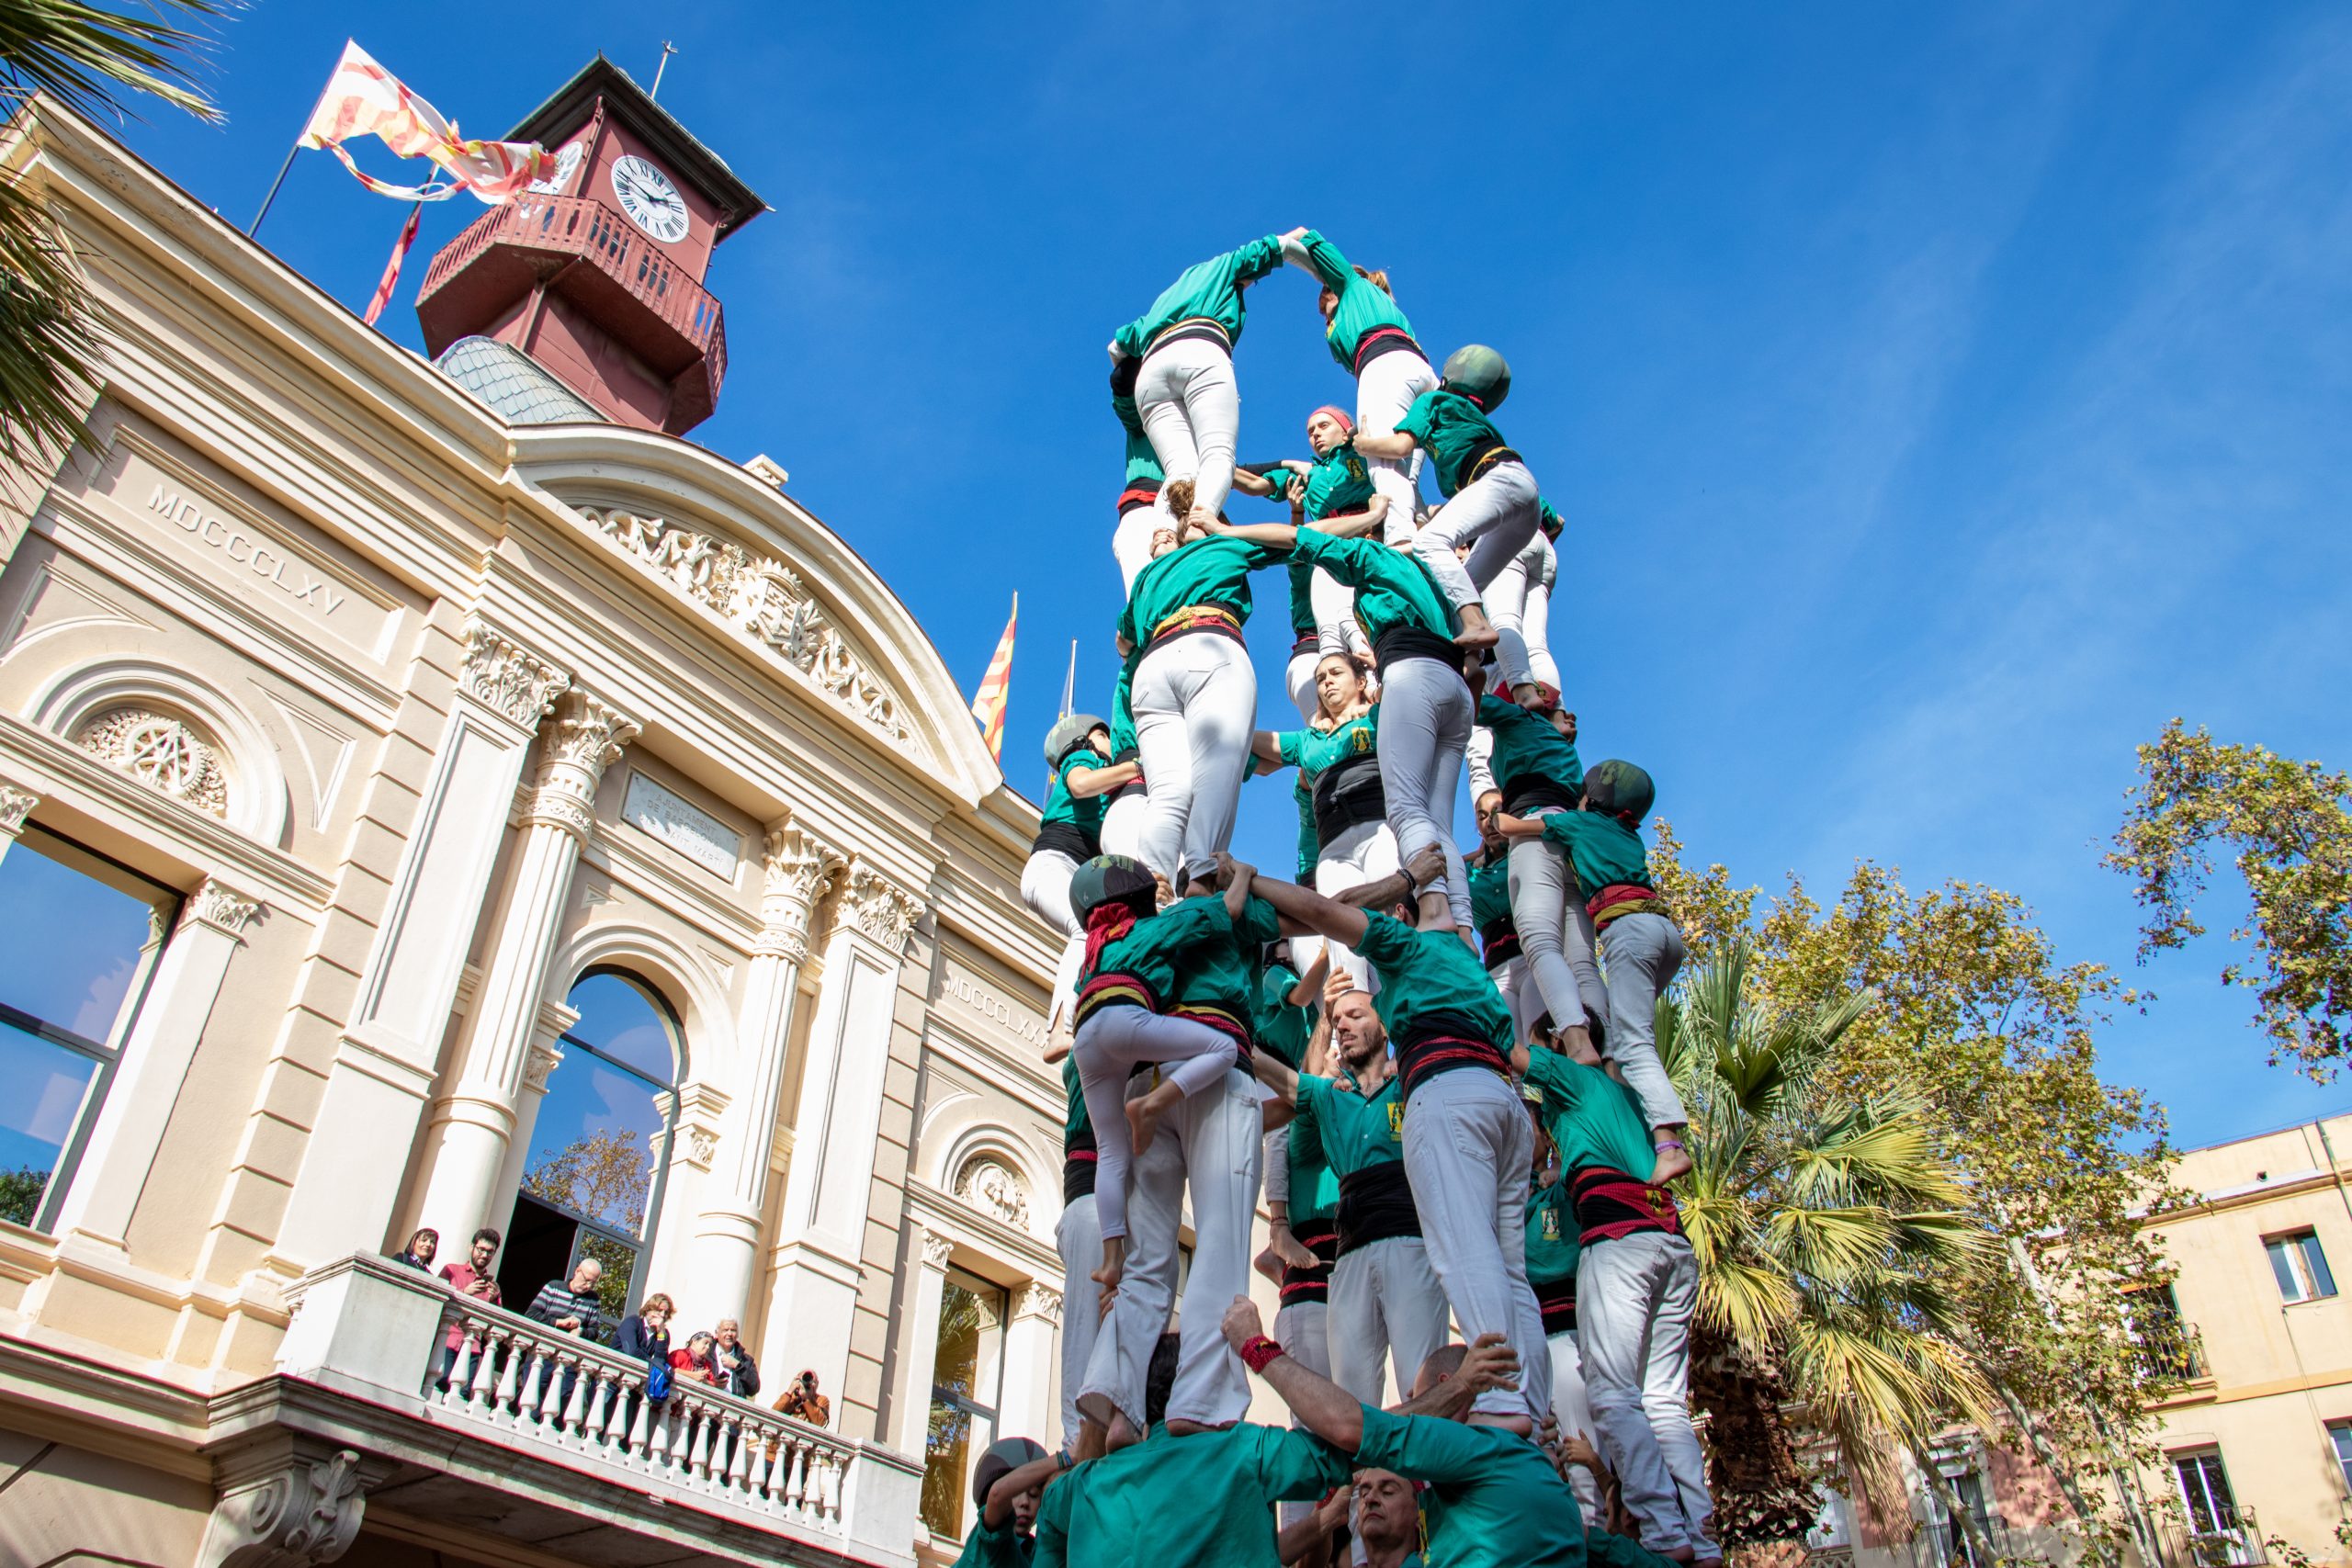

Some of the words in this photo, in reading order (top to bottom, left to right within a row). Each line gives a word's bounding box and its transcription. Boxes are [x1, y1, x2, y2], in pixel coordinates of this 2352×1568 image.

[147, 483, 345, 615] MDCCCLXV
[647, 799, 660, 813] DE
[664, 812, 721, 846] BARCELONA
[655, 794, 718, 834] AJUNTAMENT
